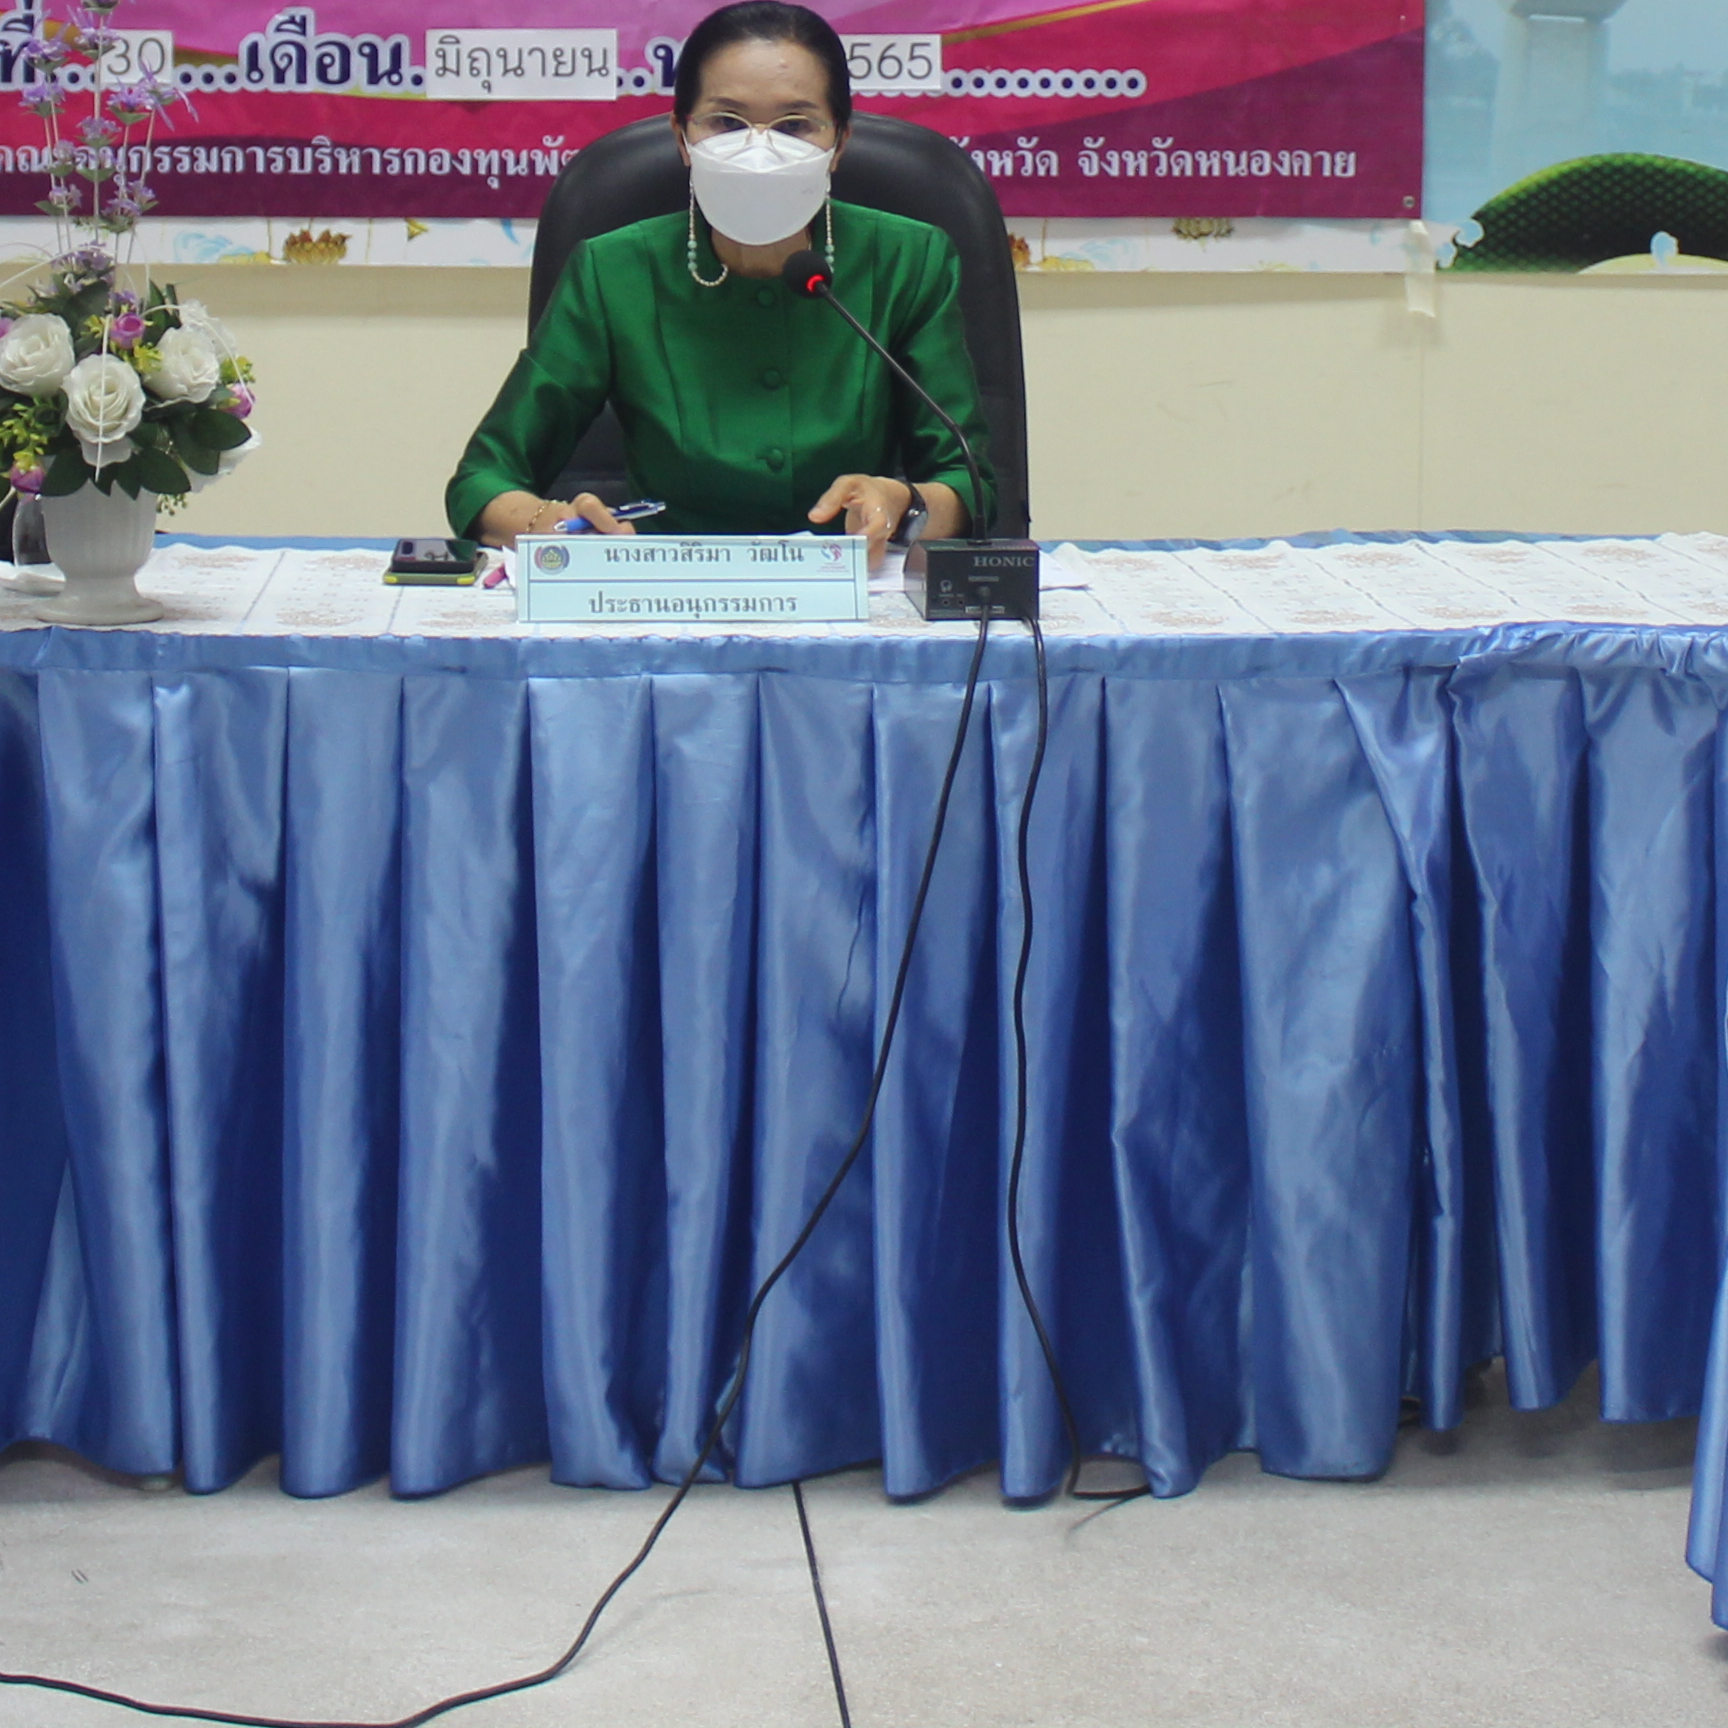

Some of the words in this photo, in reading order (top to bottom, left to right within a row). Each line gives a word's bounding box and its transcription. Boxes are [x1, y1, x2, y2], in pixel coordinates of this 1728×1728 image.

[433, 34, 608, 94] มิถุนายน
[847, 42, 933, 80] 565
[1077, 136, 1357, 178] จังหวัดหนองคาย
[588, 591, 799, 619] ประธานอนุกรรมการ
